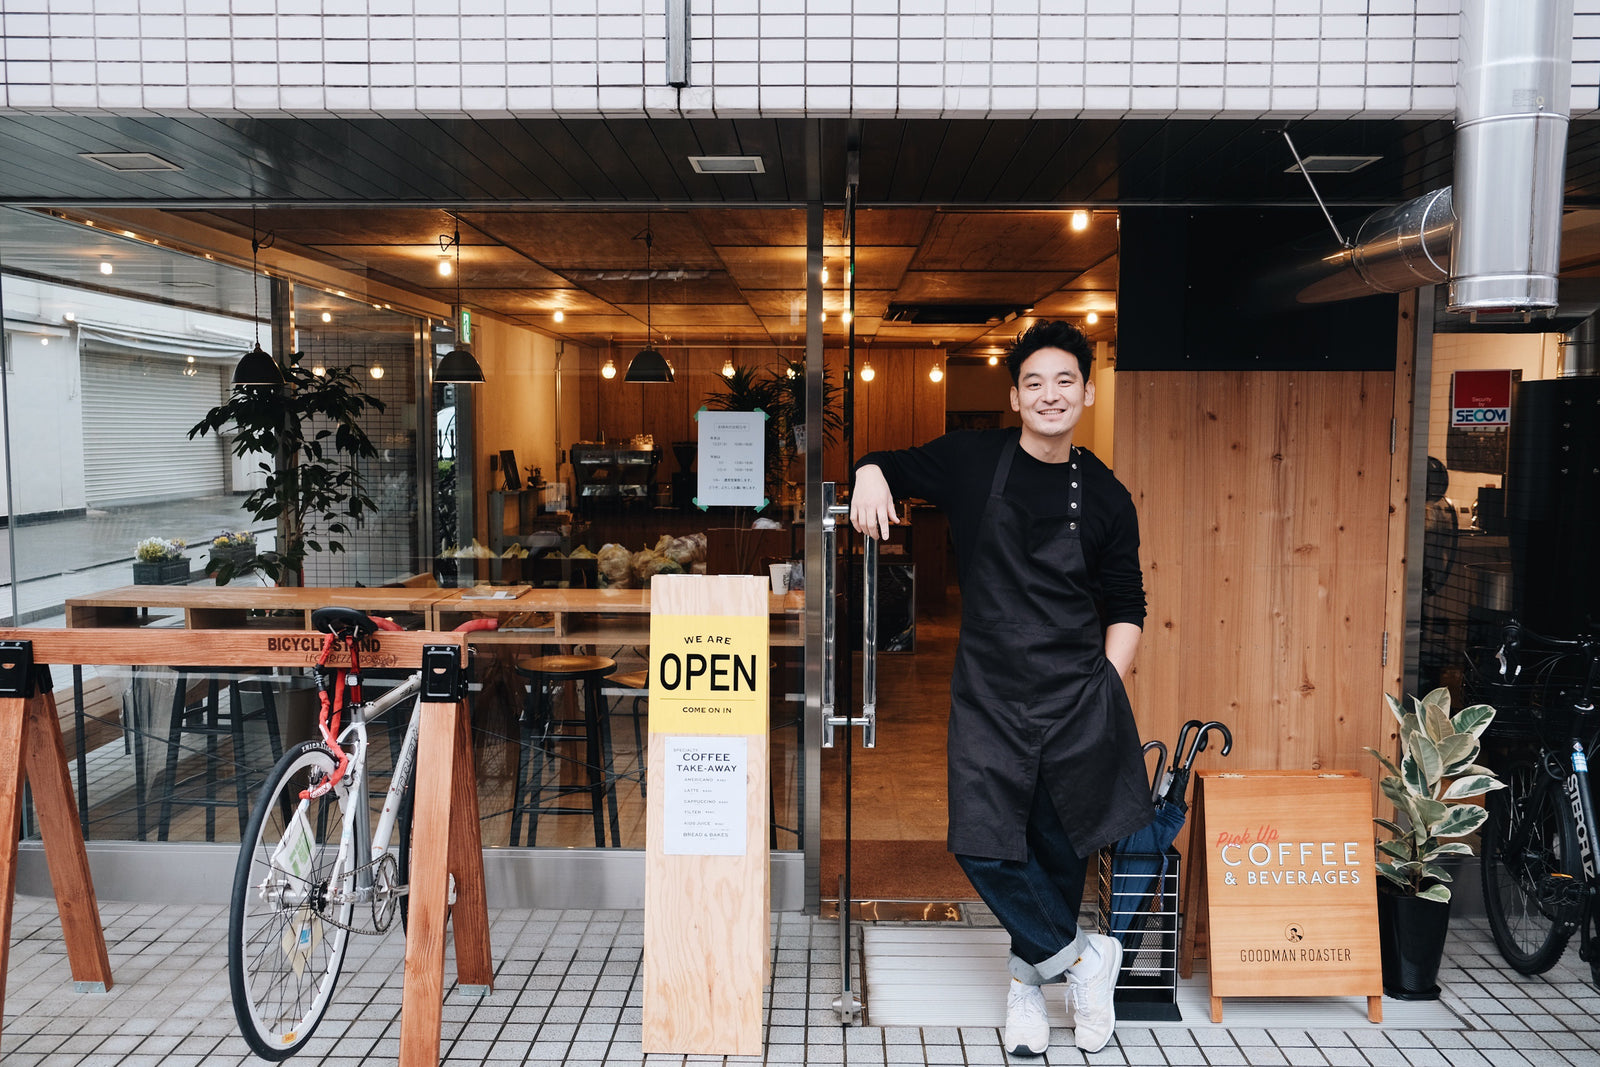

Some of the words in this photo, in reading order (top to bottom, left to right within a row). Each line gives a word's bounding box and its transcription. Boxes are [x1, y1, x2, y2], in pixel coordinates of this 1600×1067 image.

[1456, 409, 1507, 422] SECOM
[683, 635, 703, 645] WE
[707, 635, 732, 645] ARE
[660, 653, 756, 692] OPEN
[682, 706, 706, 714] COME
[682, 753, 731, 762] COFFEE
[676, 764, 737, 772] TAKE-AWAY
[1216, 828, 1250, 848] Pick
[1256, 824, 1279, 845] Up
[1221, 842, 1360, 867] COFFEE
[1224, 871, 1237, 885] &
[1247, 870, 1360, 885] BEVERAGES
[1240, 949, 1296, 962] GOODMAN
[1300, 948, 1351, 962] ROASTER
